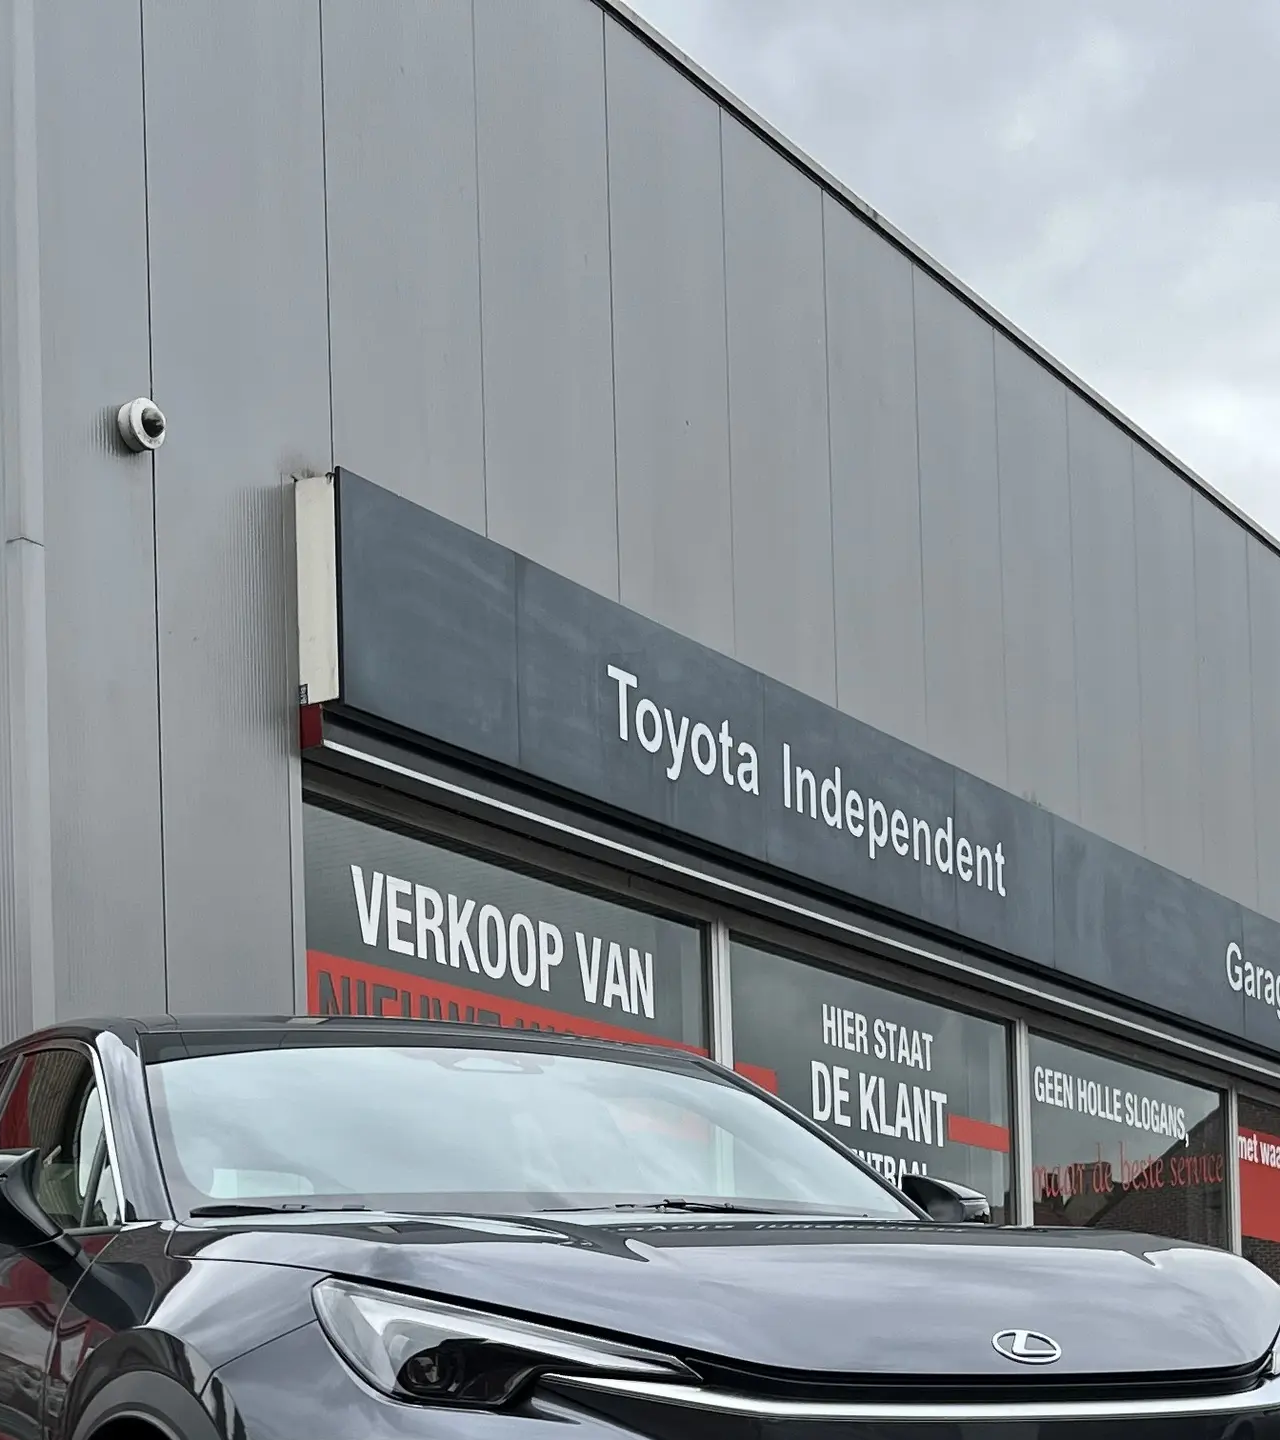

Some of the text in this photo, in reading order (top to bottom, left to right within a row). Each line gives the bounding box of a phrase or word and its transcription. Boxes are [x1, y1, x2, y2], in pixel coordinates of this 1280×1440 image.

[608, 664, 1007, 898] Toyota Independent
[351, 865, 564, 992] VERKOOP
[575, 931, 656, 1019] VAN
[823, 1003, 933, 1072] HIER STAAT
[811, 1060, 947, 1147] DE KLANT
[1034, 1066, 1190, 1148] GEEN HOLLE SLOGANS,
[1092, 1142, 1115, 1193] de
[1120, 1141, 1165, 1190] beste
[1170, 1152, 1224, 1187] service
[1237, 1133, 1259, 1163] met
